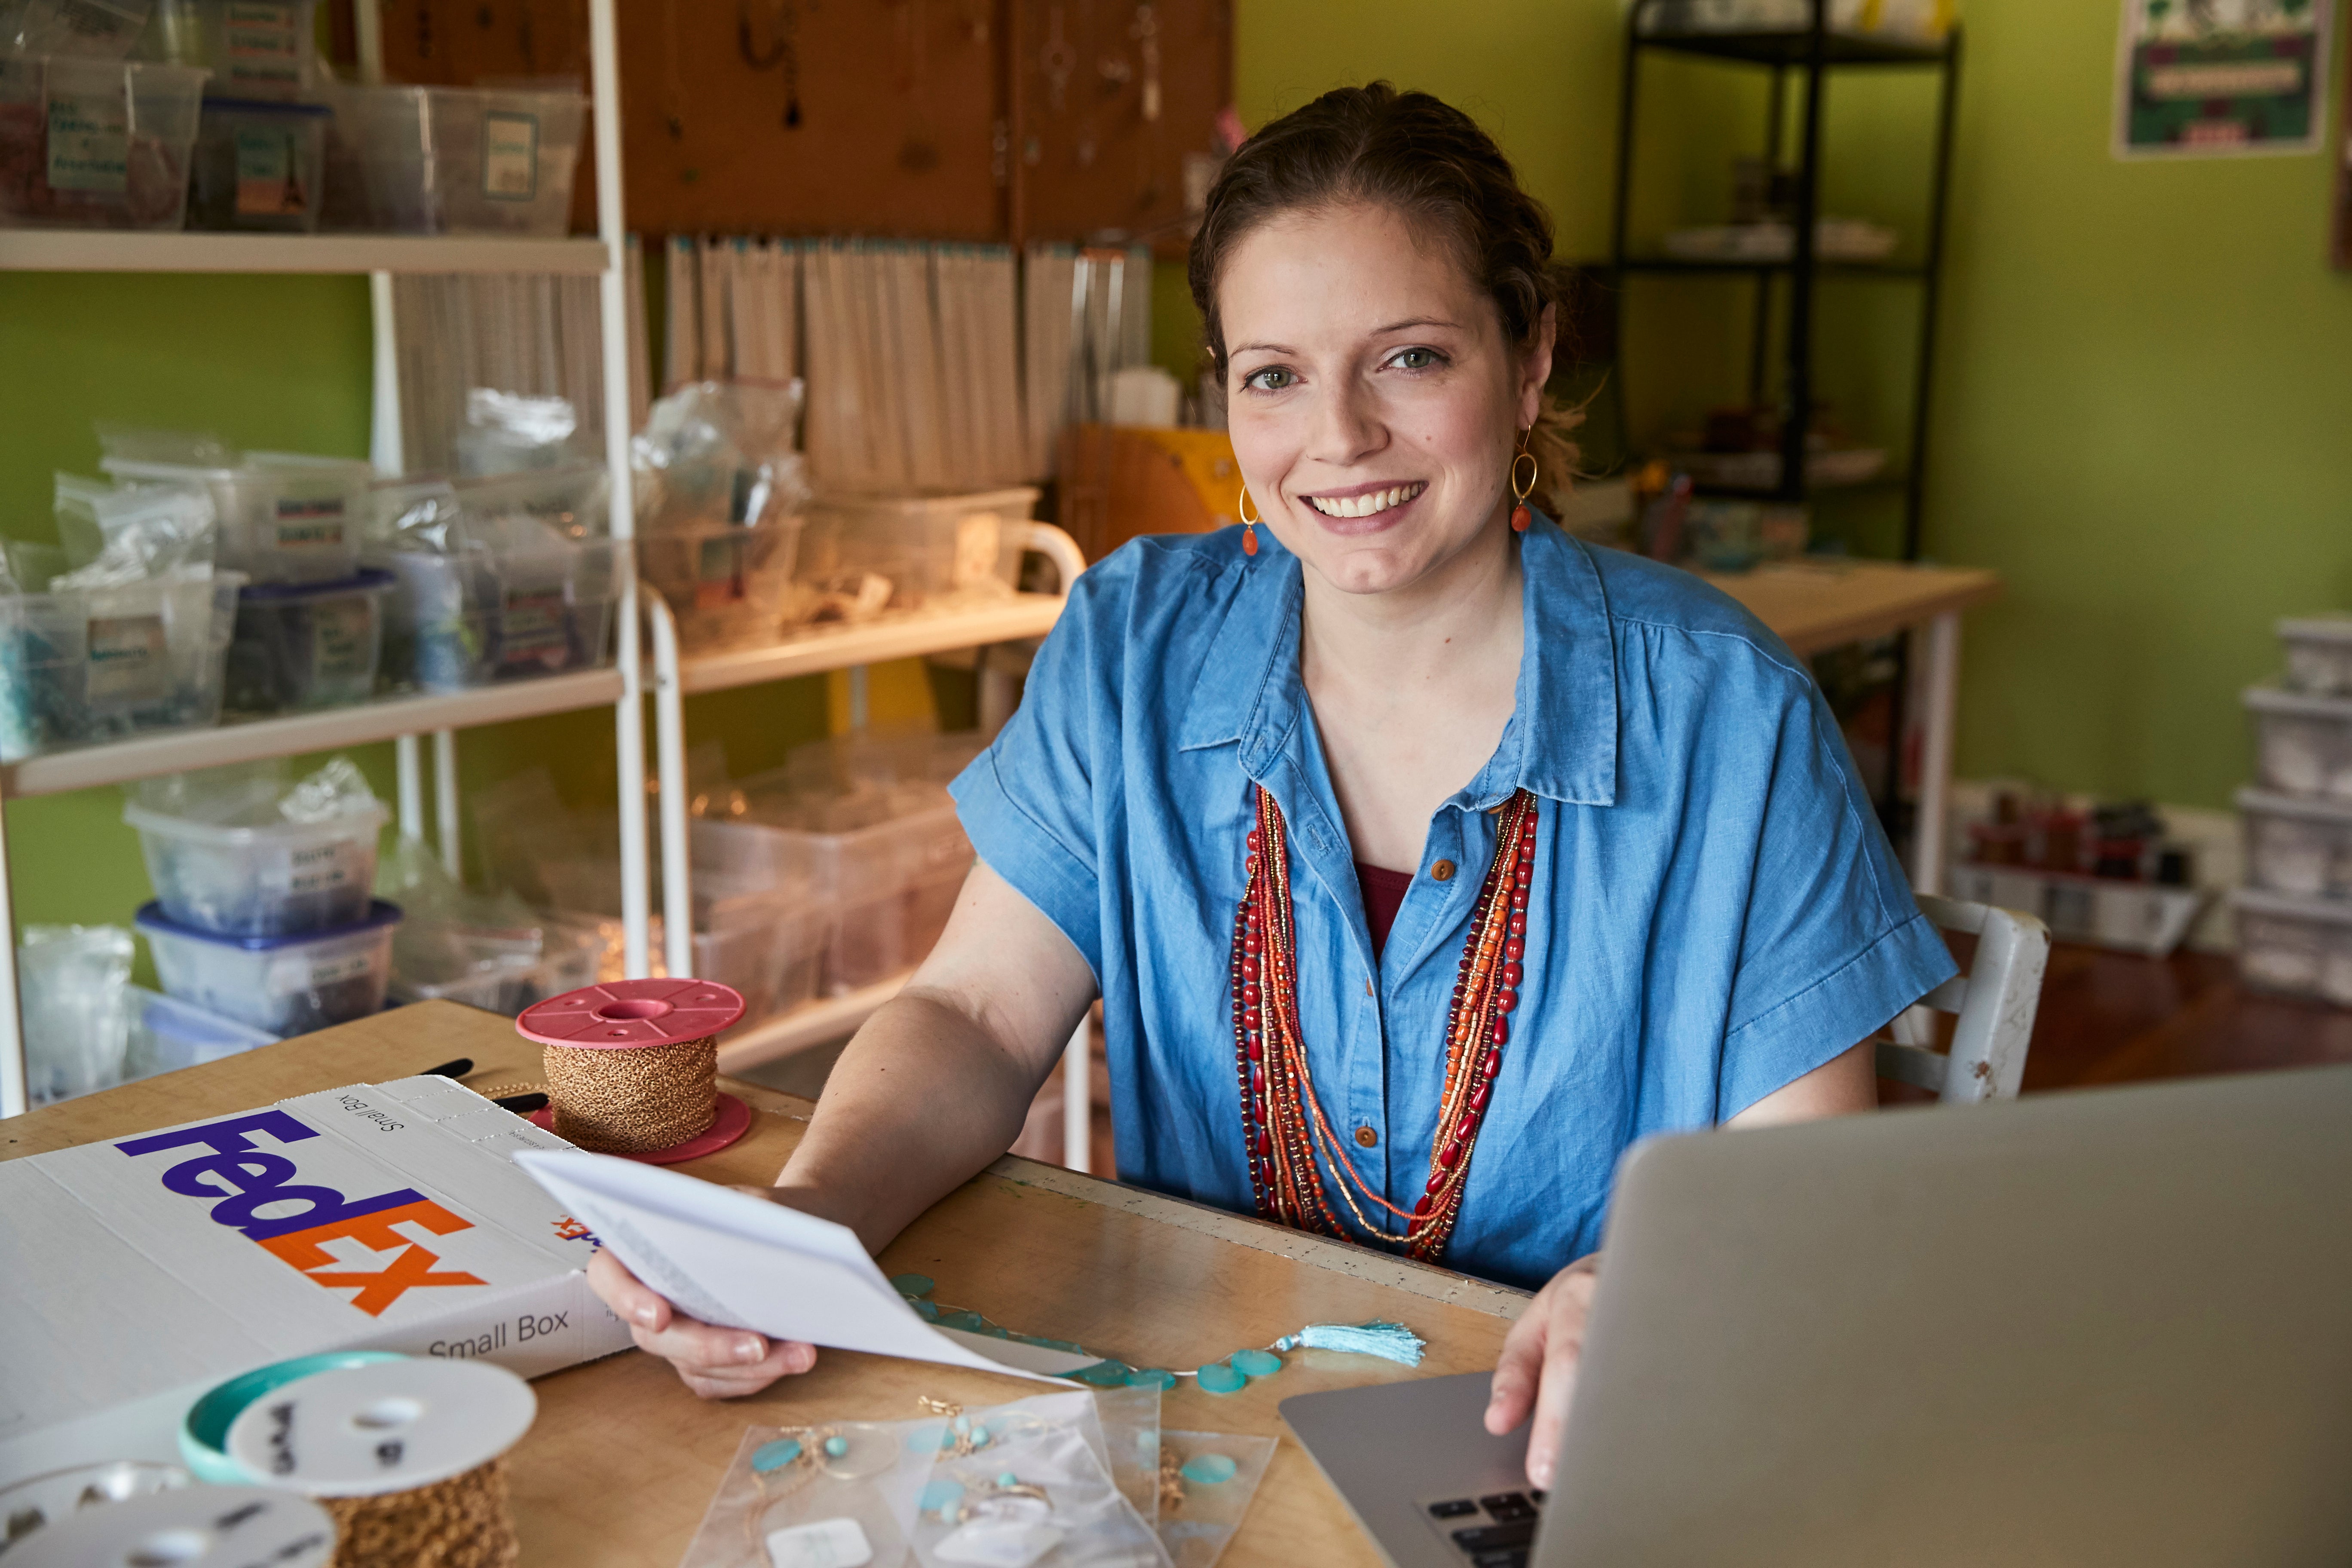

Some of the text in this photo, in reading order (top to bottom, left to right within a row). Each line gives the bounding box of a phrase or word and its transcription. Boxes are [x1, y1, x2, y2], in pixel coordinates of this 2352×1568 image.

[334, 1095, 404, 1131] Small Box
[113, 1109, 491, 1317] FedEx
[429, 1322, 505, 1358] Small
[519, 1311, 568, 1341] Box
